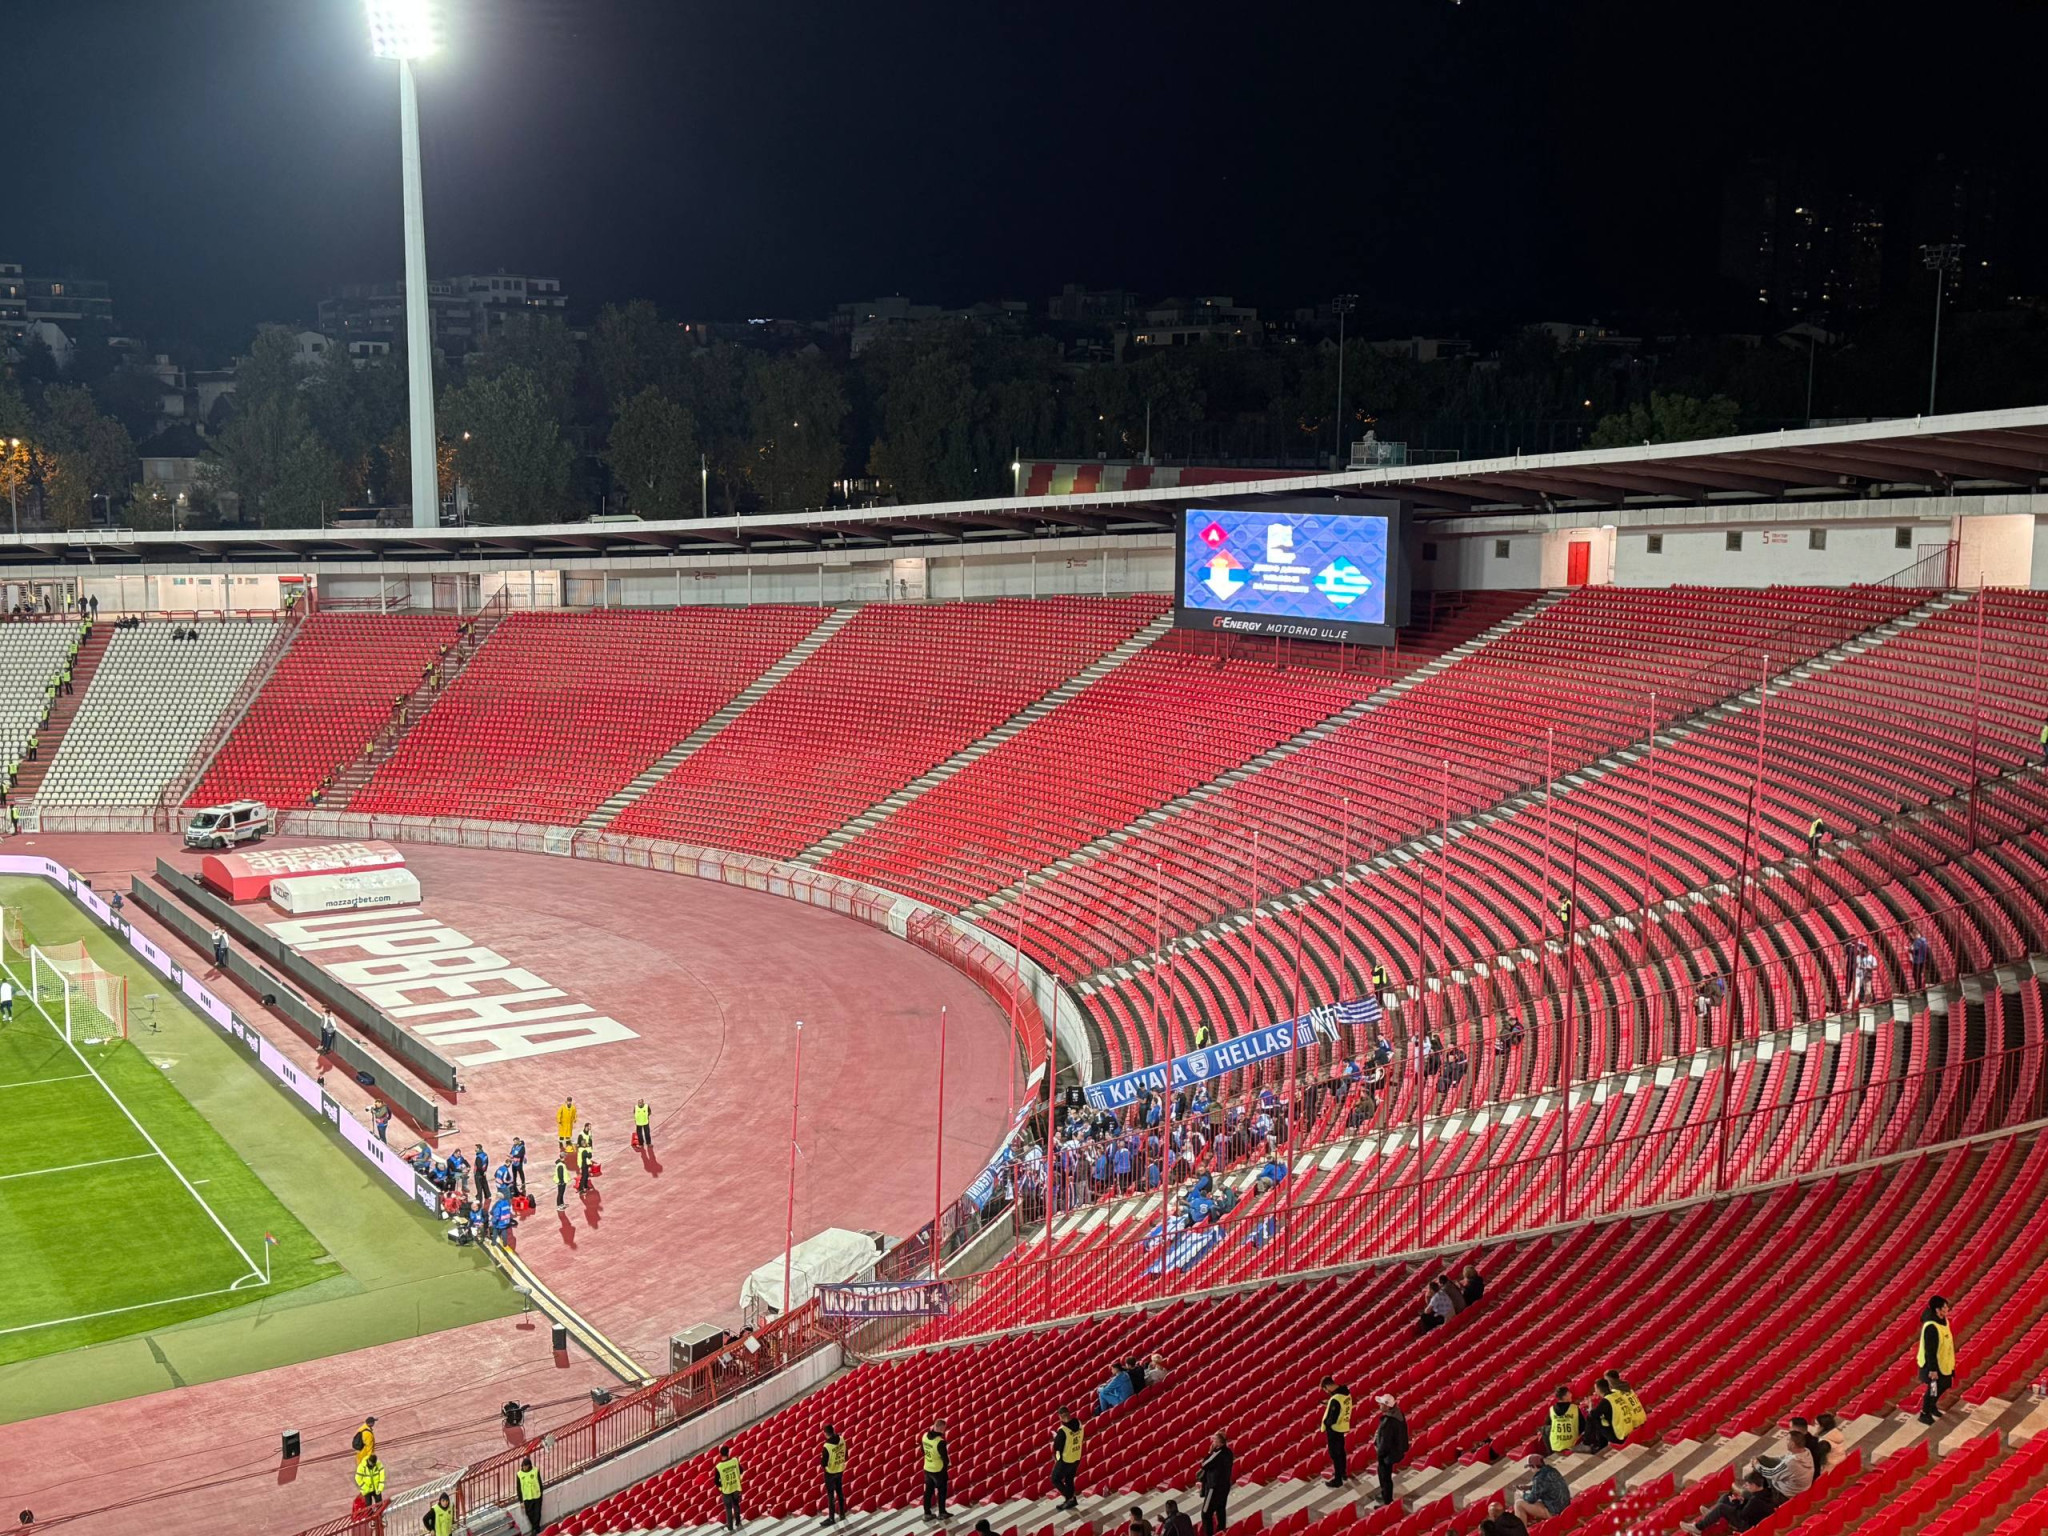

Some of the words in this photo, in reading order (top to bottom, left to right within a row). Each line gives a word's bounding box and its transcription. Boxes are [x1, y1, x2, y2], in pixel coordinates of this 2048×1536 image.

[1762, 530, 1770, 545] 5
[1266, 623, 1318, 637] MOTORNO
[1321, 629, 1349, 639] ULJE
[325, 894, 391, 908] mozzartbet.com
[1109, 1063, 1188, 1103] KAVALA
[1214, 1028, 1293, 1069] HELLAS
[1557, 1423, 1572, 1433] 616
